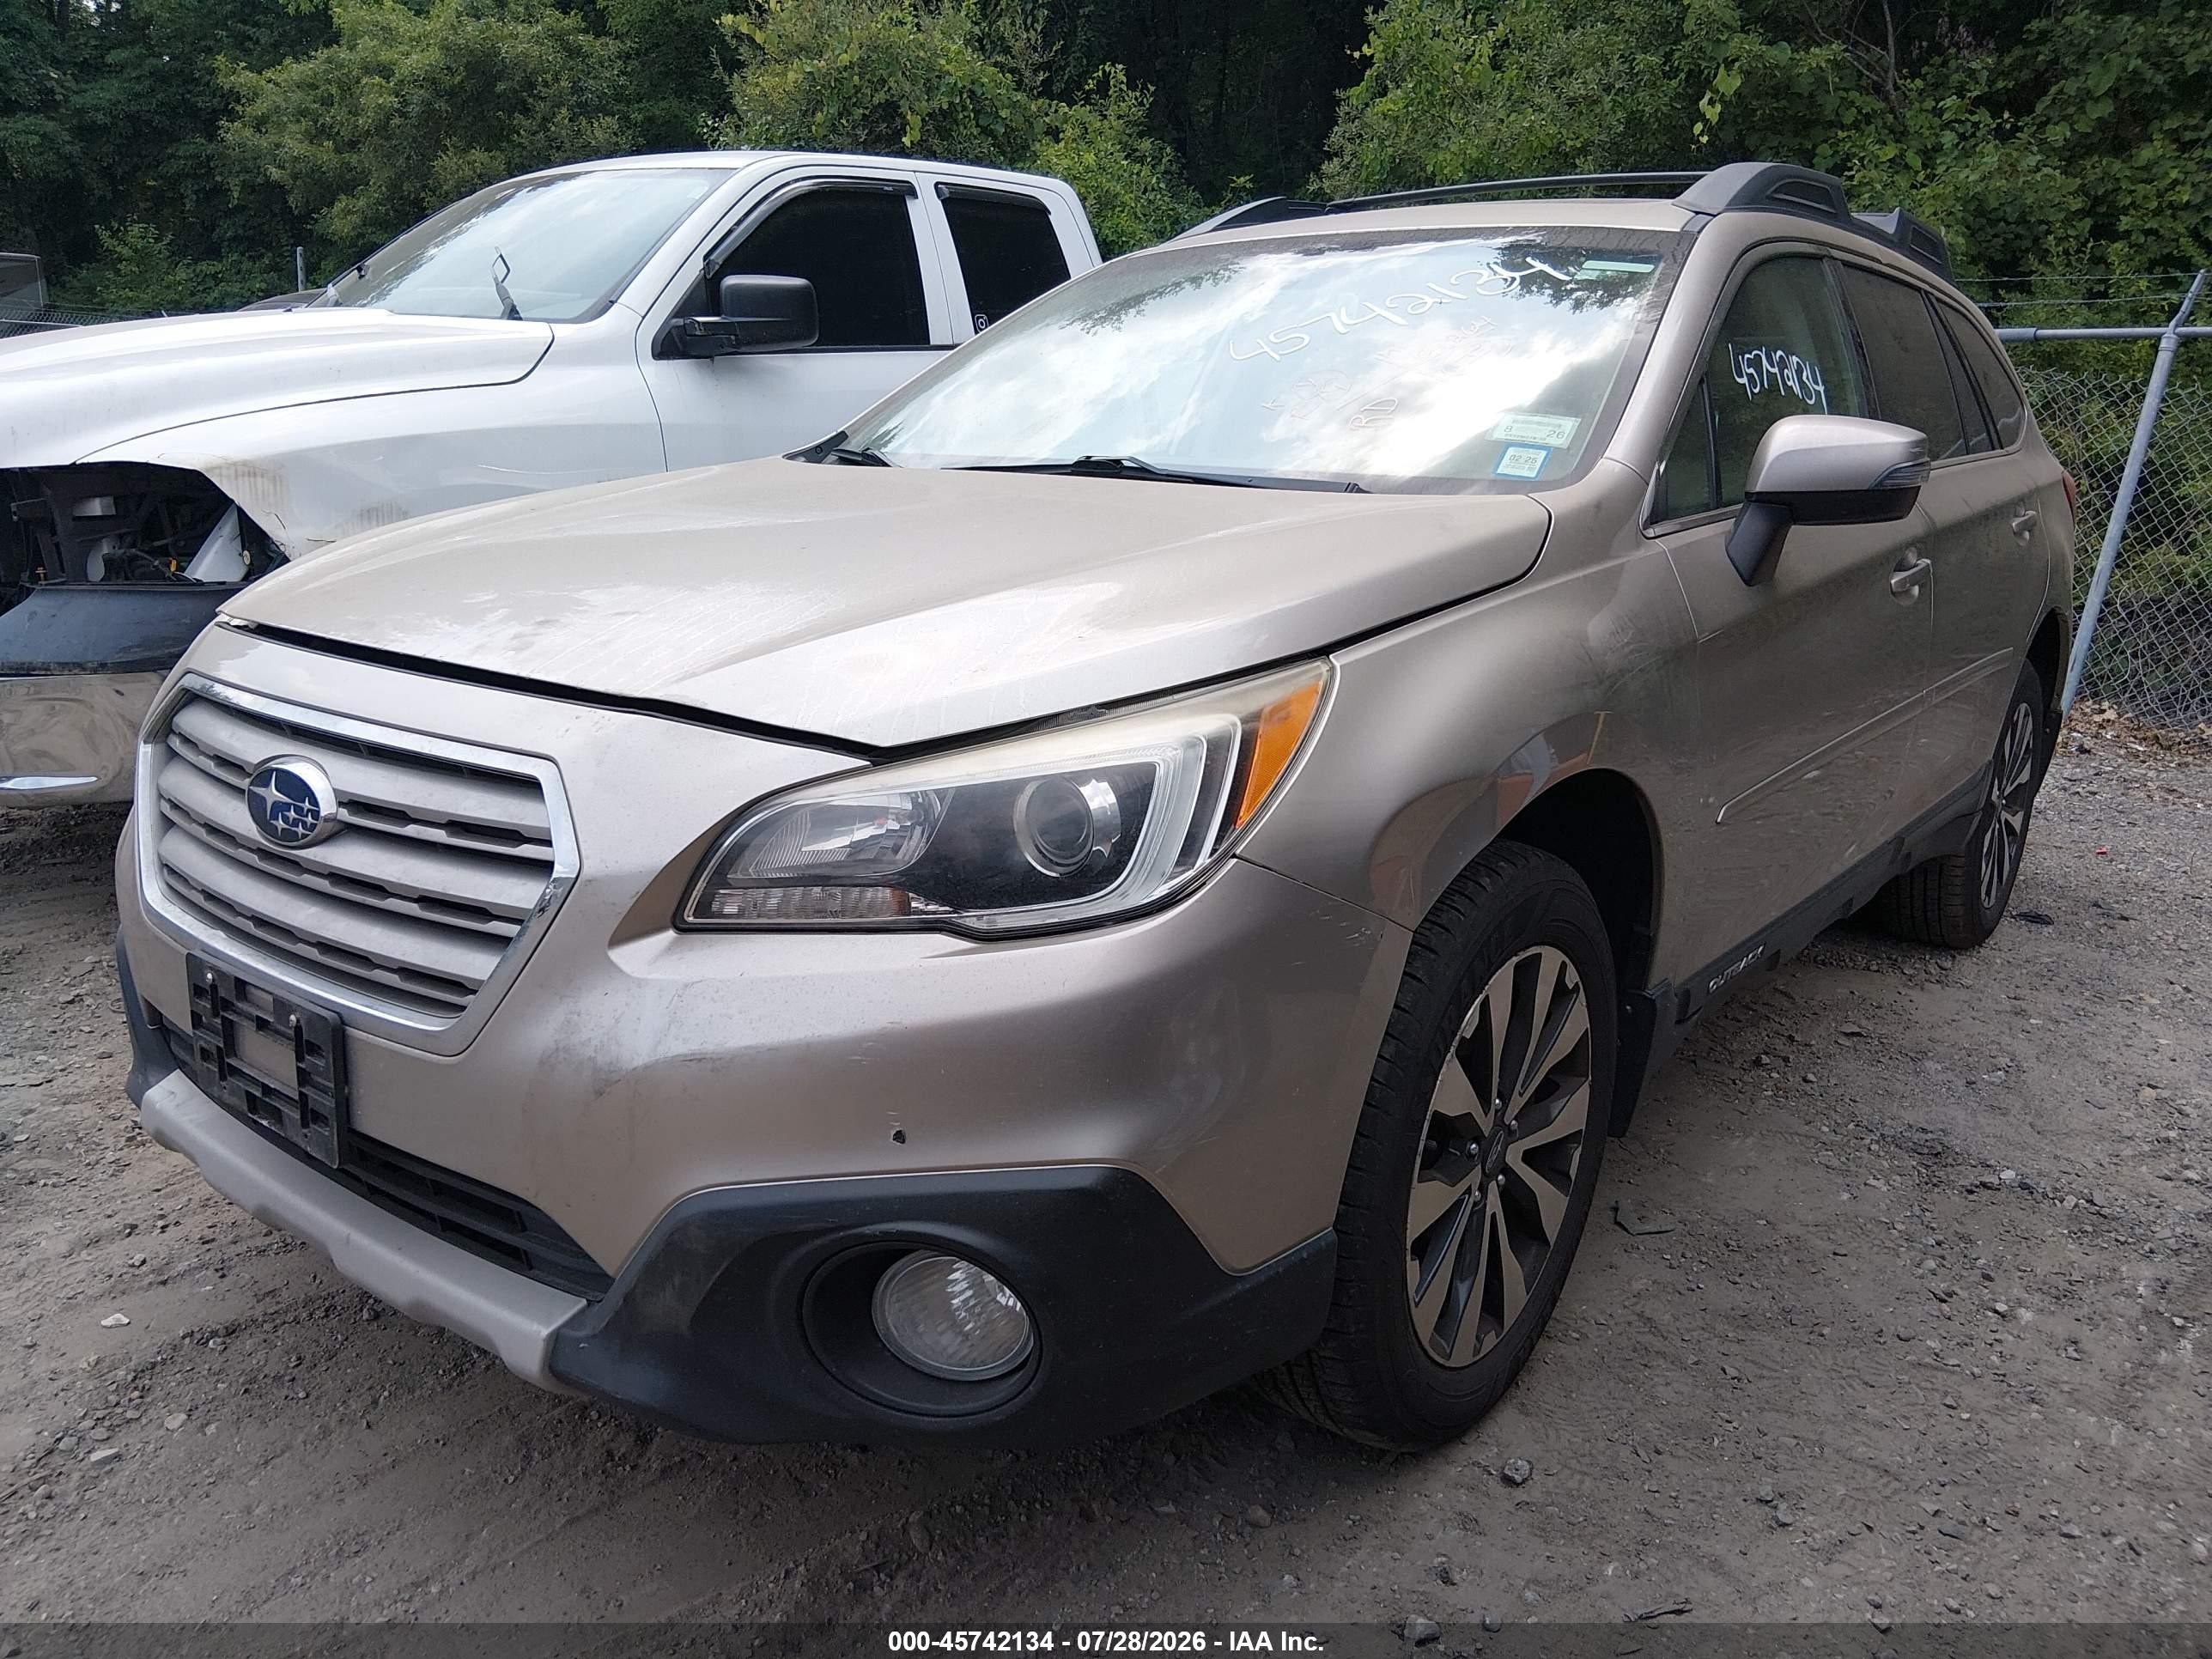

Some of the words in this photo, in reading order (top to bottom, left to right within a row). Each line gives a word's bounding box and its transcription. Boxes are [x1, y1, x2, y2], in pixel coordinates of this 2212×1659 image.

[1229, 257, 1572, 362] 45742134
[1728, 343, 1828, 415] 45742134
[1547, 429, 1565, 439] 26
